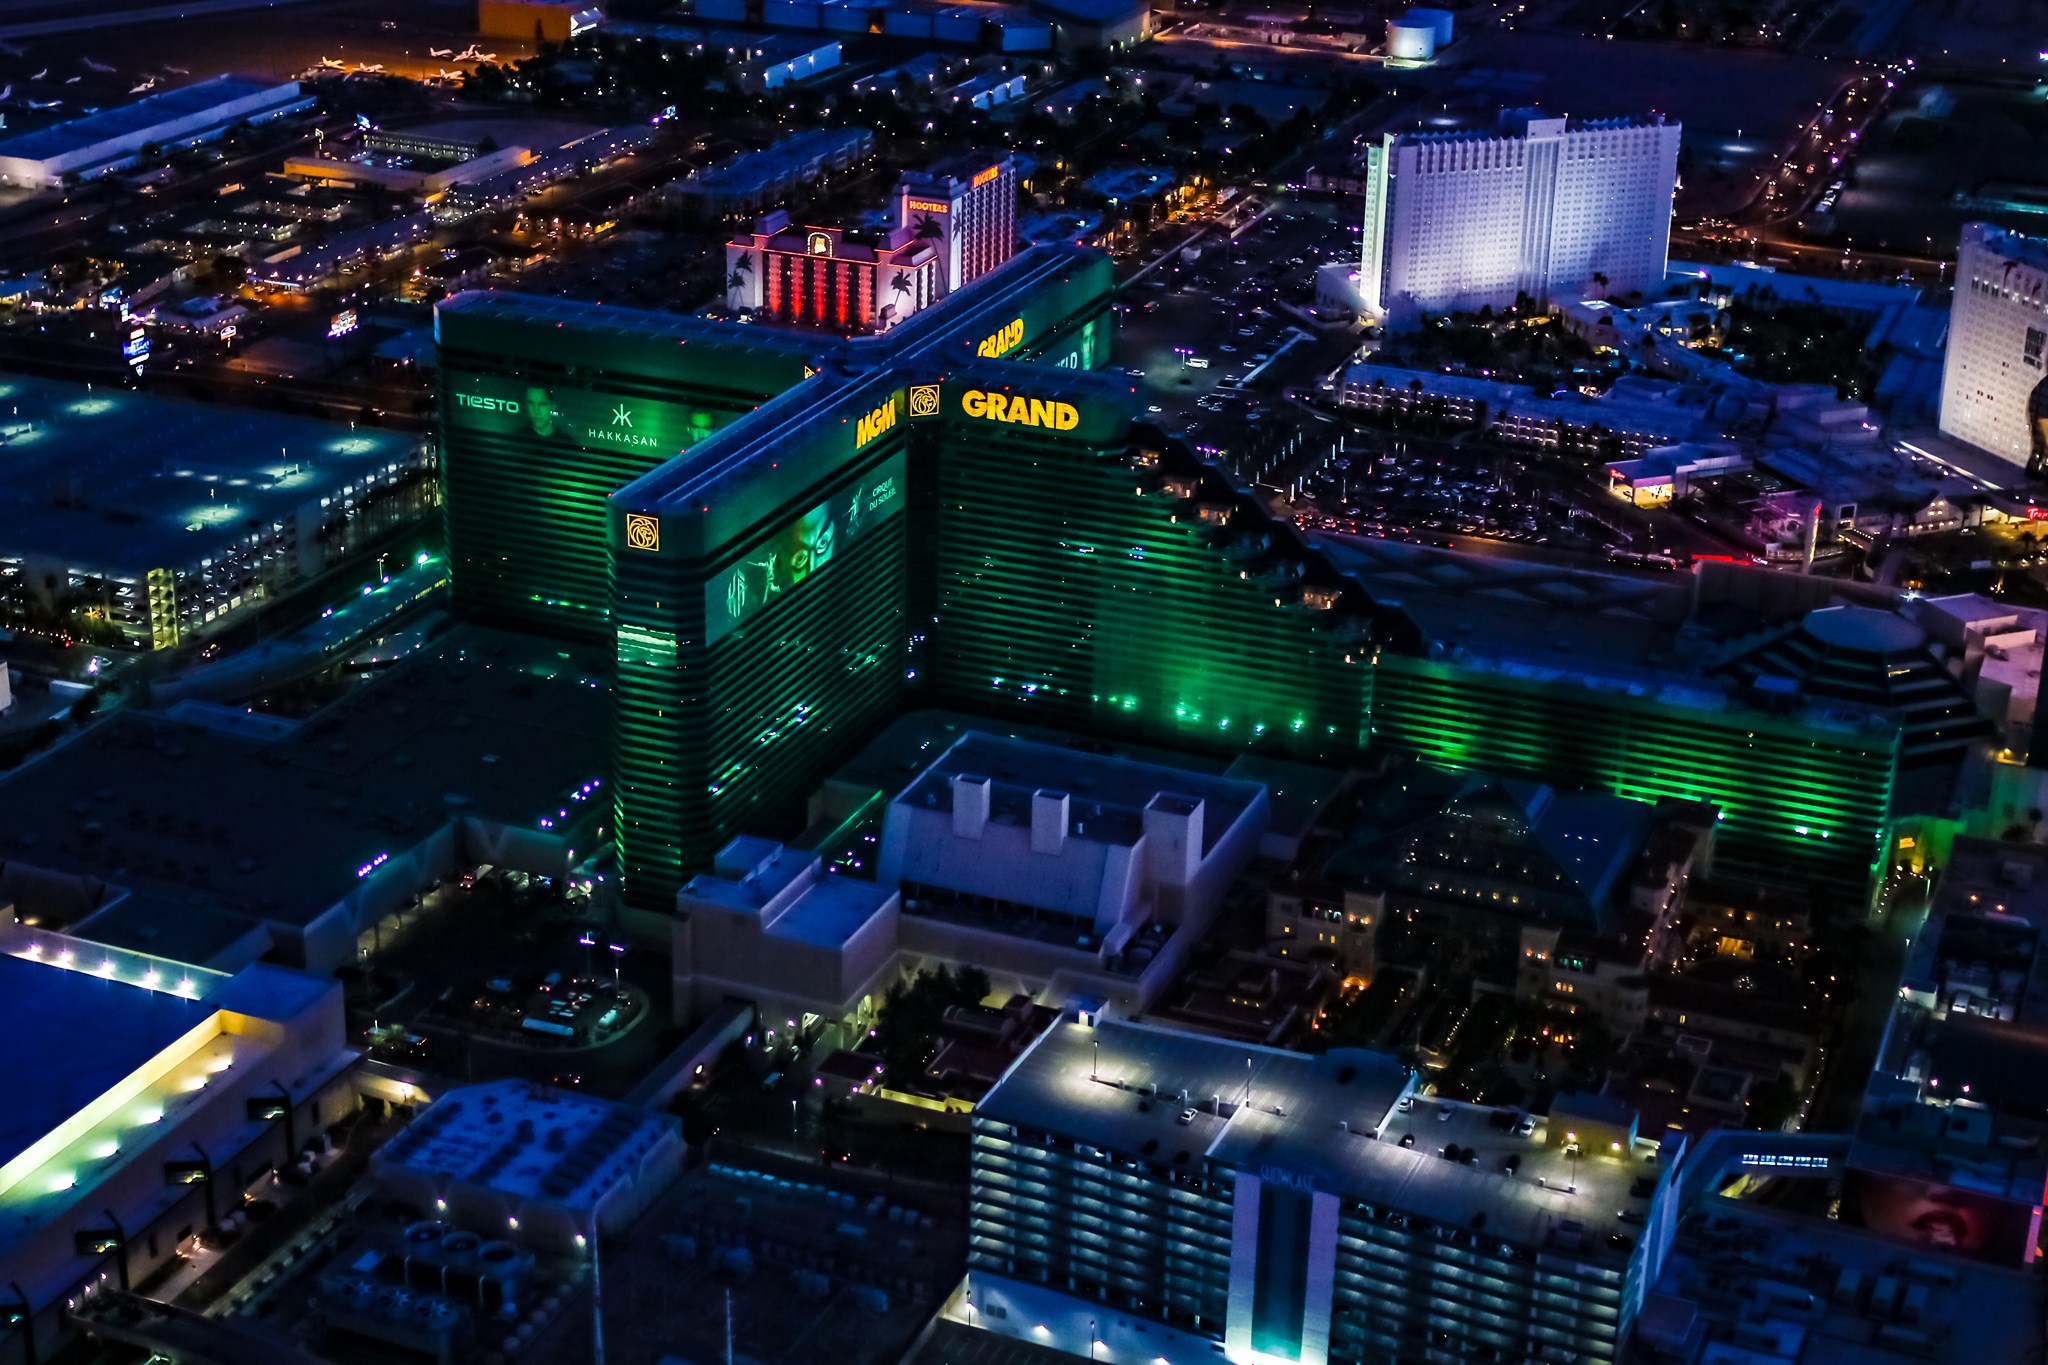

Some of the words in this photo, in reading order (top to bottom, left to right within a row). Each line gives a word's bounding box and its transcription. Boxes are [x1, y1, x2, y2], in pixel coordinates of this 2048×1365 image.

[908, 200, 948, 213] HOOTERS
[962, 389, 1079, 431] GRAND
[856, 398, 897, 449] MGM
[588, 428, 658, 447] HAKKASAN
[872, 477, 893, 497] CIRQUE
[869, 499, 877, 511] DU
[878, 487, 897, 505] SOLEIL
